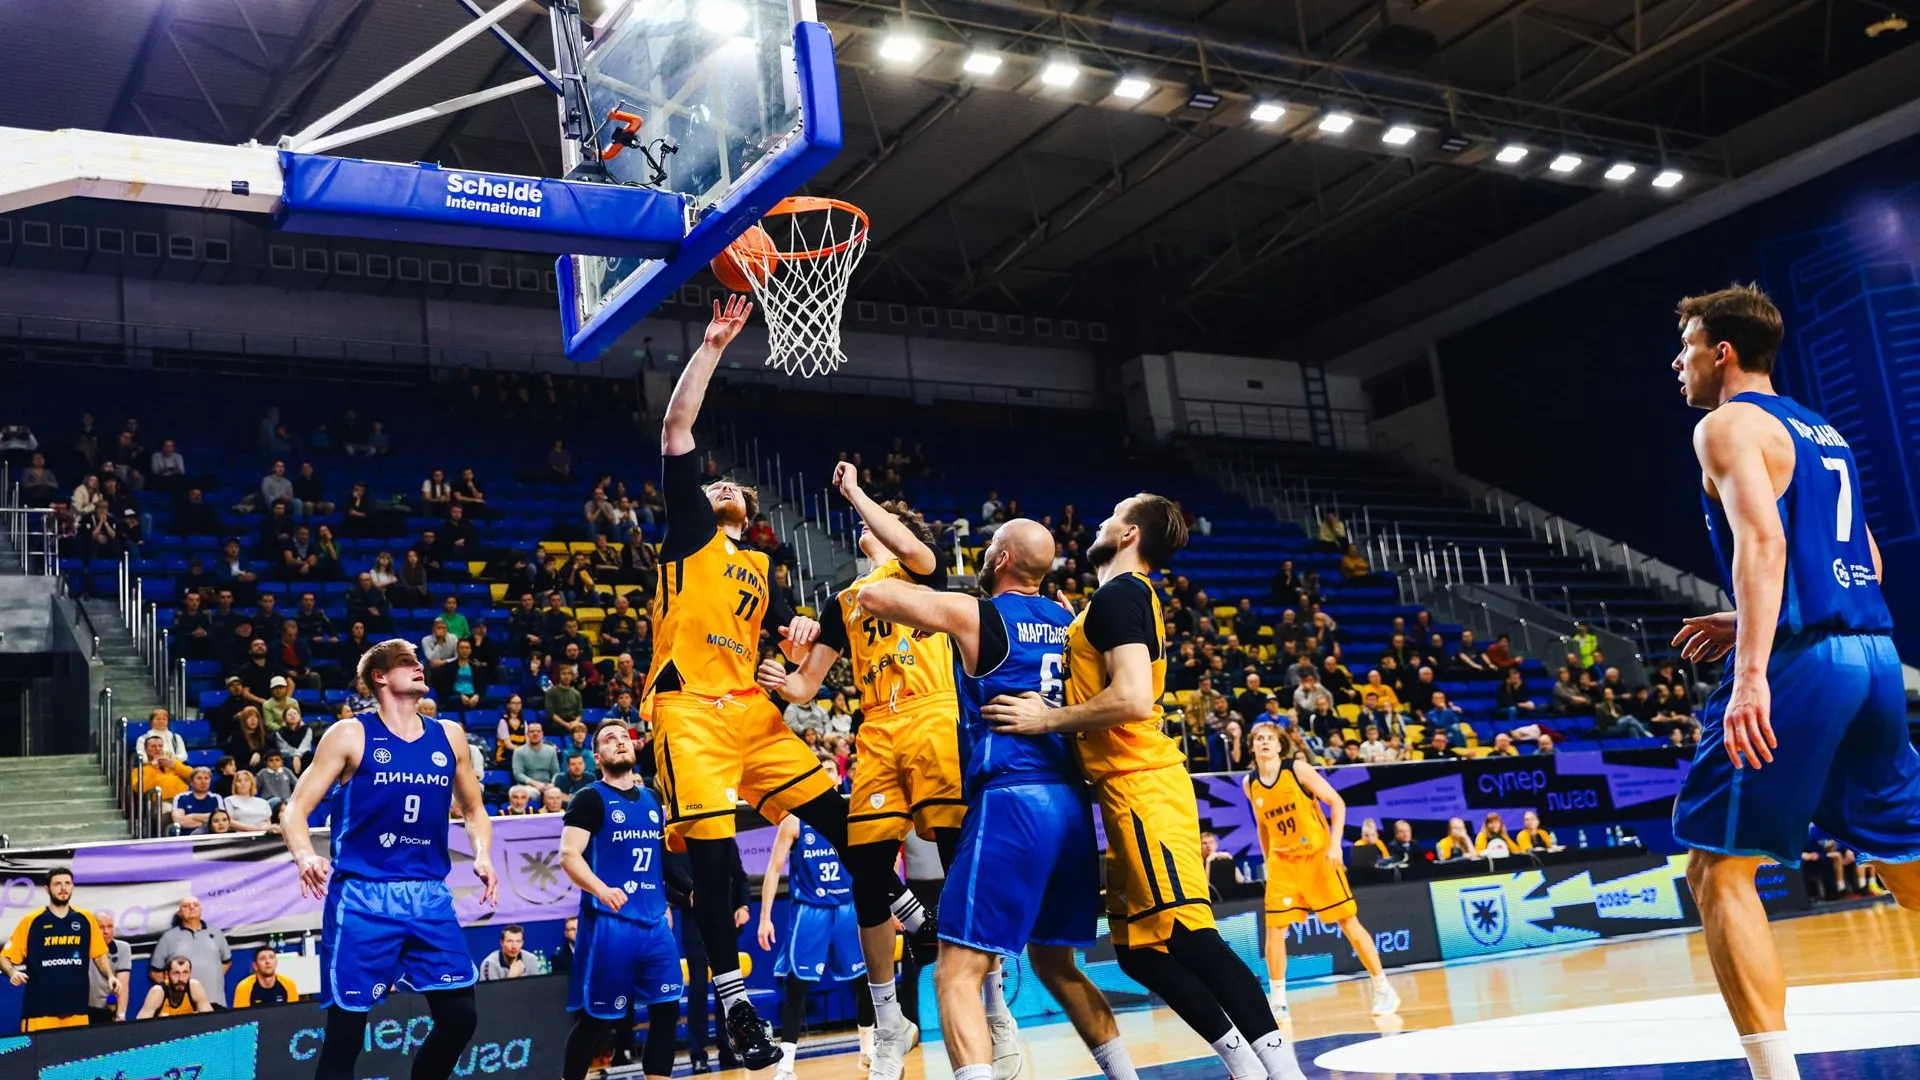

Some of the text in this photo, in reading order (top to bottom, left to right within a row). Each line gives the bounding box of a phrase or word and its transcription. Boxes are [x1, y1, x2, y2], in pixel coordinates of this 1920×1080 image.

[447, 174, 543, 203] Schelde
[446, 195, 541, 218] International
[1820, 456, 1852, 542] 7
[735, 589, 760, 621] 71
[1016, 622, 1068, 644] МАРТЫНО
[373, 771, 449, 787] ДИНАМО
[403, 794, 421, 824] 9
[1277, 816, 1296, 836] 99
[632, 847, 653, 872] 27
[803, 848, 836, 859] ДИНА
[819, 861, 841, 882] 32
[43, 935, 81, 947] ХИМКИ
